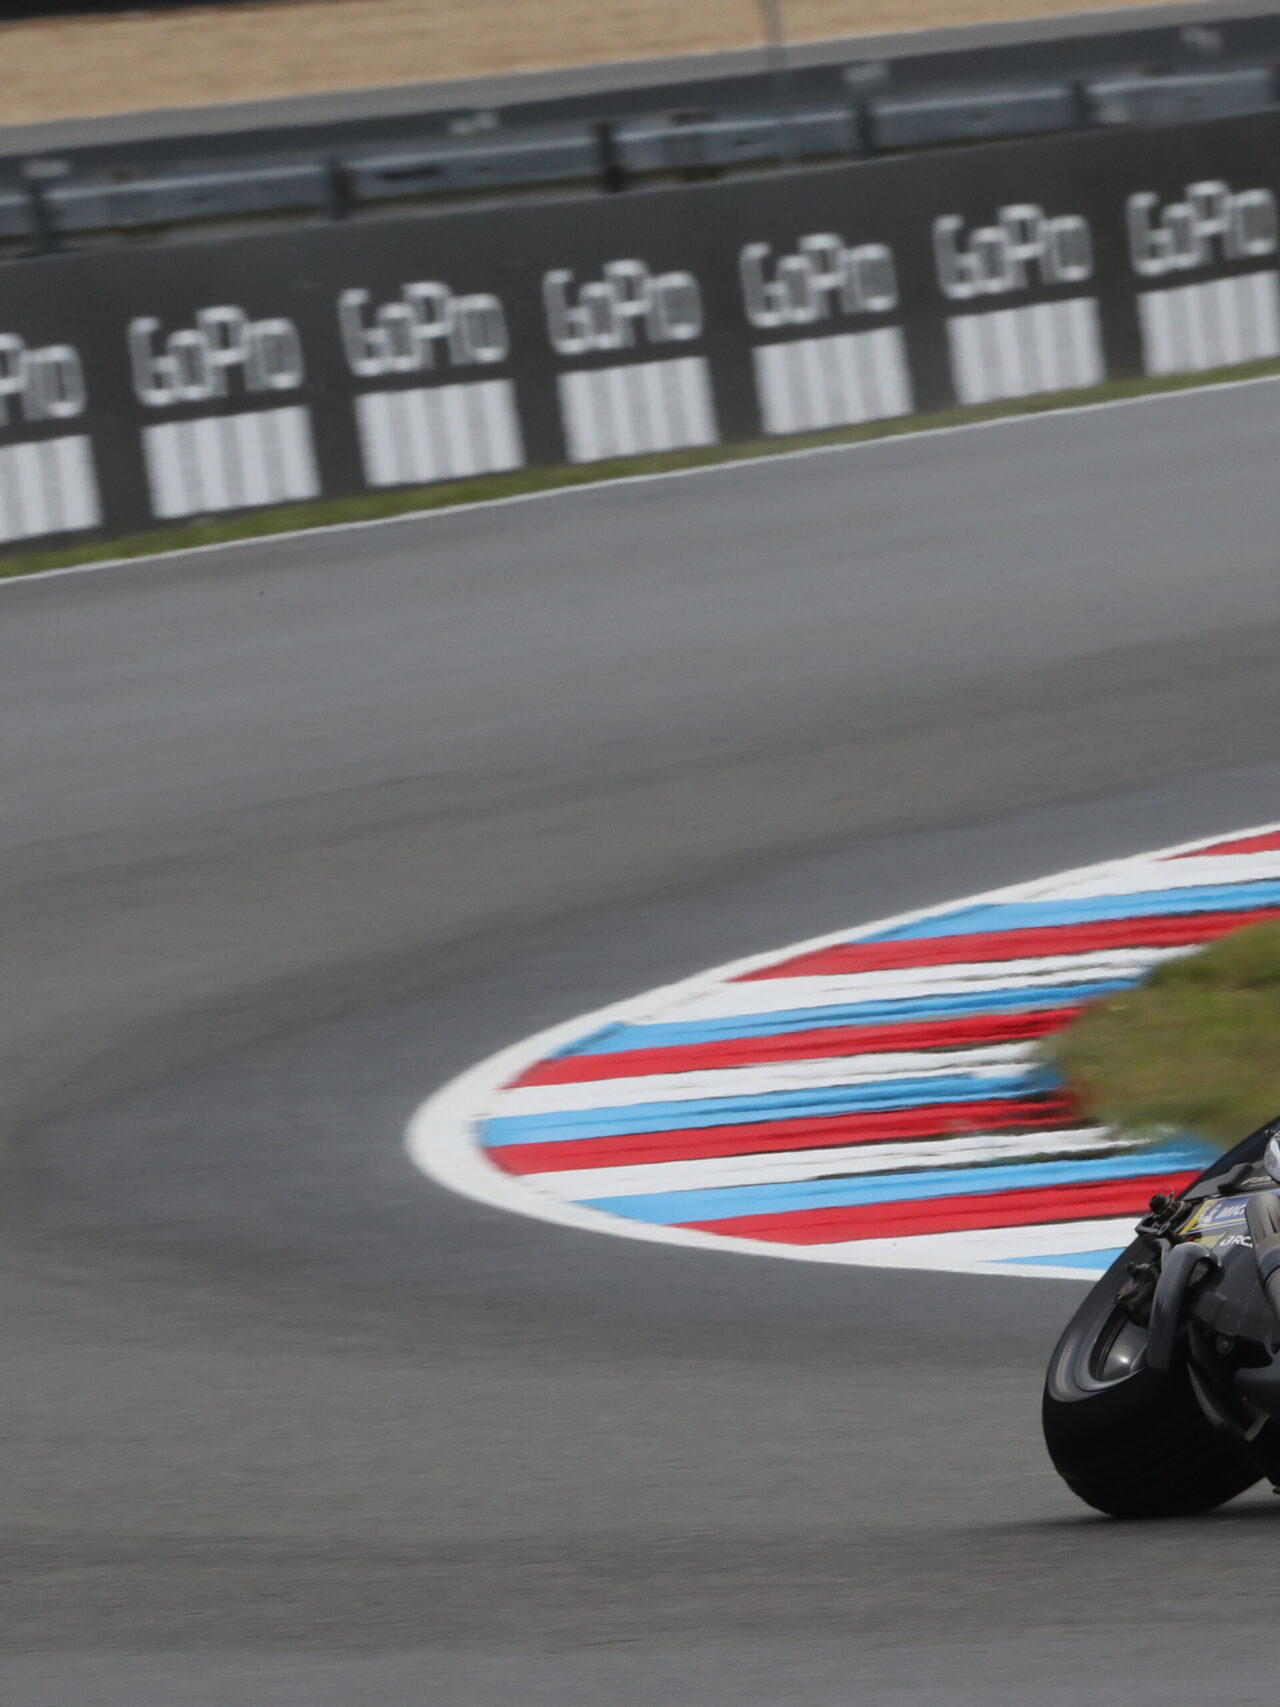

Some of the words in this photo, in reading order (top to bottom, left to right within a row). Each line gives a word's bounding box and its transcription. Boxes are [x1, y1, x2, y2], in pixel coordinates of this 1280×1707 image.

[932, 204, 1094, 300] GoPro
[1127, 180, 1278, 276] GoPro
[338, 281, 510, 376] GoPro
[542, 259, 704, 355] GoPro
[739, 233, 898, 328] GoPro
[0, 333, 86, 426] Pro
[127, 305, 305, 406] GoPro
